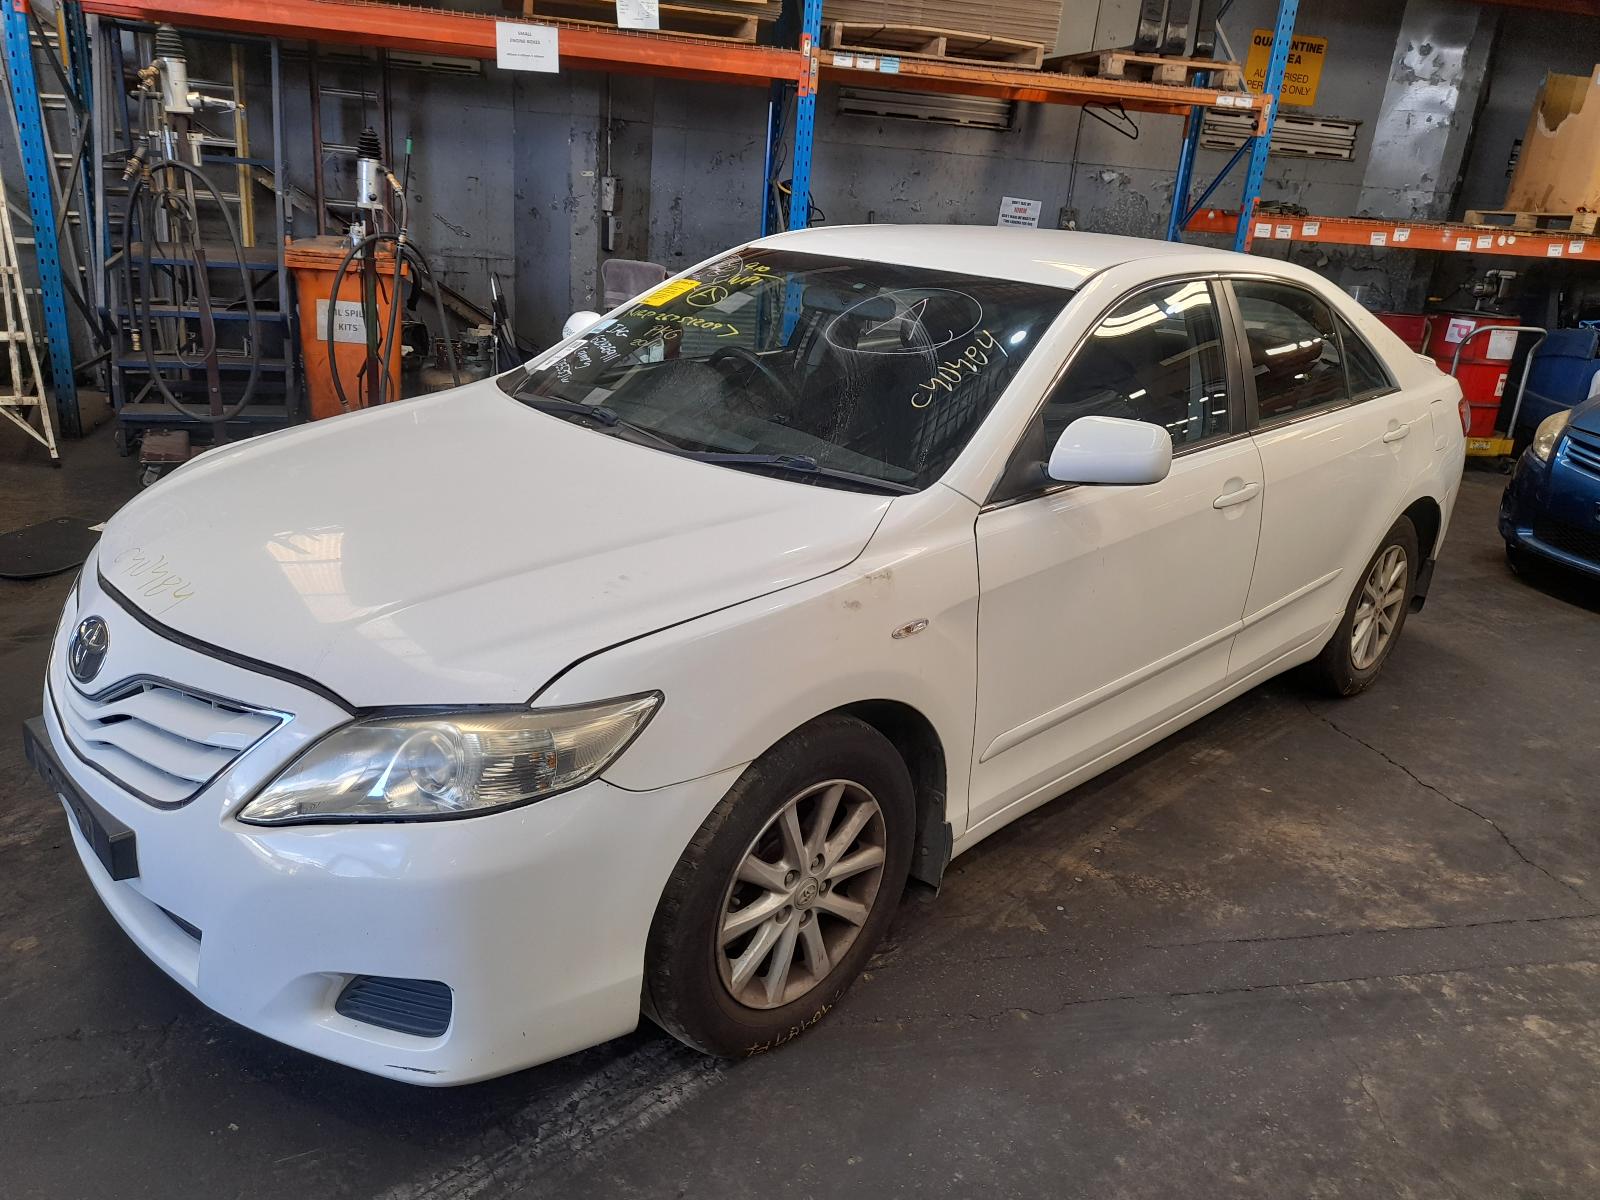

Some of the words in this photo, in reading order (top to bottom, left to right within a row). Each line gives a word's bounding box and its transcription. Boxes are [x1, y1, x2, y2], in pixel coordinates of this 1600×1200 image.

[1253, 35, 1324, 54] QUANTINE
[1254, 68, 1309, 84] AURISED
[1247, 80, 1288, 94] PERS
[1288, 85, 1311, 96] ONLY
[345, 310, 365, 318] SPIL
[338, 323, 358, 331] KITS
